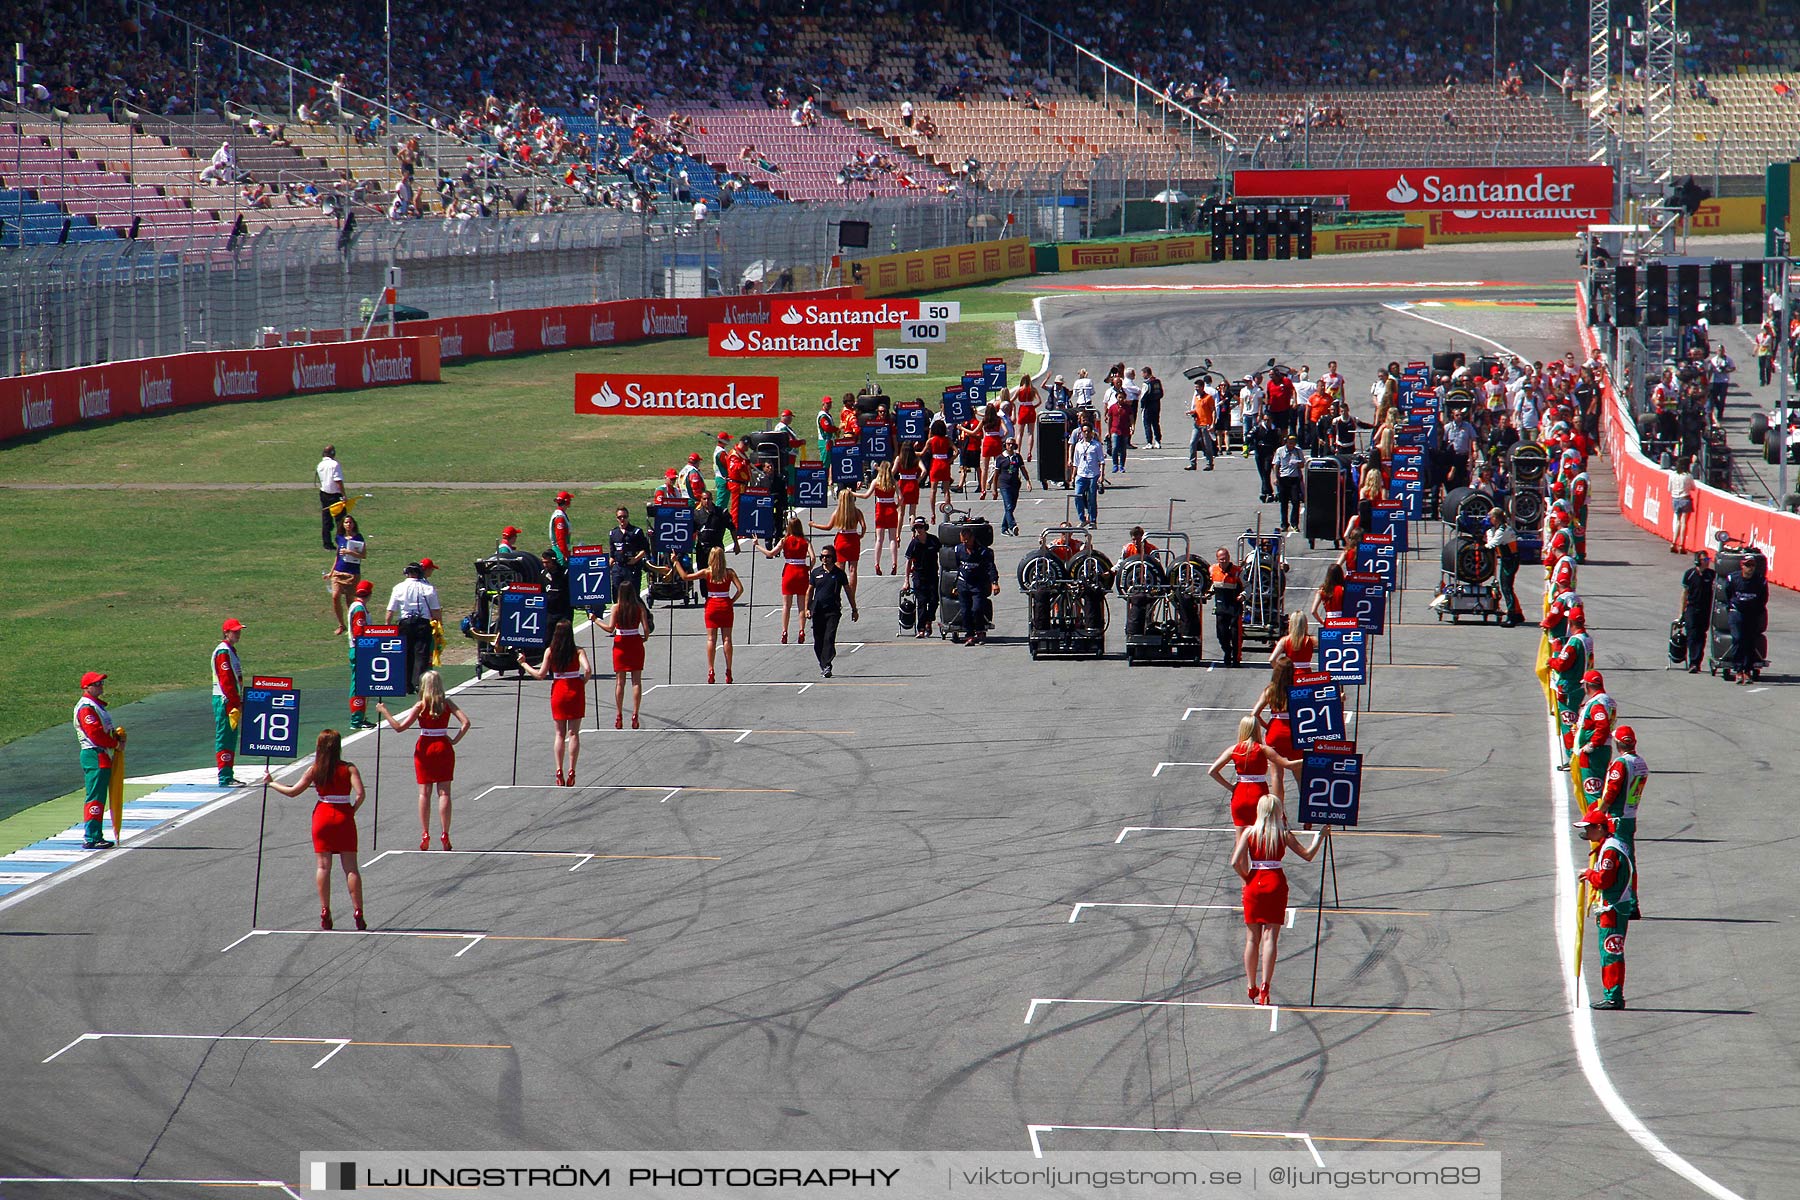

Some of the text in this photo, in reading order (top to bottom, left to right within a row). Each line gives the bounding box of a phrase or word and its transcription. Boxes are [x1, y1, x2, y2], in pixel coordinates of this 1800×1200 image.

[1423, 173, 1575, 203] Santander
[1335, 233, 1389, 251] PIRELLI
[1072, 248, 1120, 266] PIRELLI
[390, 275, 396, 285] 1
[651, 304, 688, 335] Santander
[806, 304, 908, 325] Santander
[929, 306, 949, 320] 50
[908, 324, 939, 338] 100
[748, 329, 862, 352] Santander
[300, 349, 336, 389] Santander
[370, 343, 412, 383] Santander
[884, 355, 919, 370] 150
[222, 356, 258, 396] Santander
[990, 373, 1000, 386] 7
[625, 383, 765, 413] Santander
[970, 386, 980, 399] 6
[952, 401, 963, 416] 3
[905, 419, 916, 434] 5
[866, 437, 886, 453] 15
[841, 458, 854, 474] 8
[799, 481, 824, 499] 24
[750, 509, 760, 528] 1
[659, 523, 689, 542] 25
[1383, 523, 1397, 541] 4
[1362, 559, 1391, 580] 12
[576, 572, 604, 594] 17
[1356, 600, 1372, 622] 2
[509, 611, 540, 635] 14
[371, 656, 391, 682] 9
[1325, 648, 1360, 672] 22
[261, 680, 289, 688] Santander
[1302, 675, 1328, 683] Santander
[253, 713, 290, 741] 18
[1297, 705, 1332, 734] 21
[257, 744, 292, 752] HARYANTO
[1324, 744, 1351, 752] Santander
[1308, 778, 1354, 808] 20
[1319, 811, 1328, 819] DE
[1328, 812, 1347, 820] JONG
